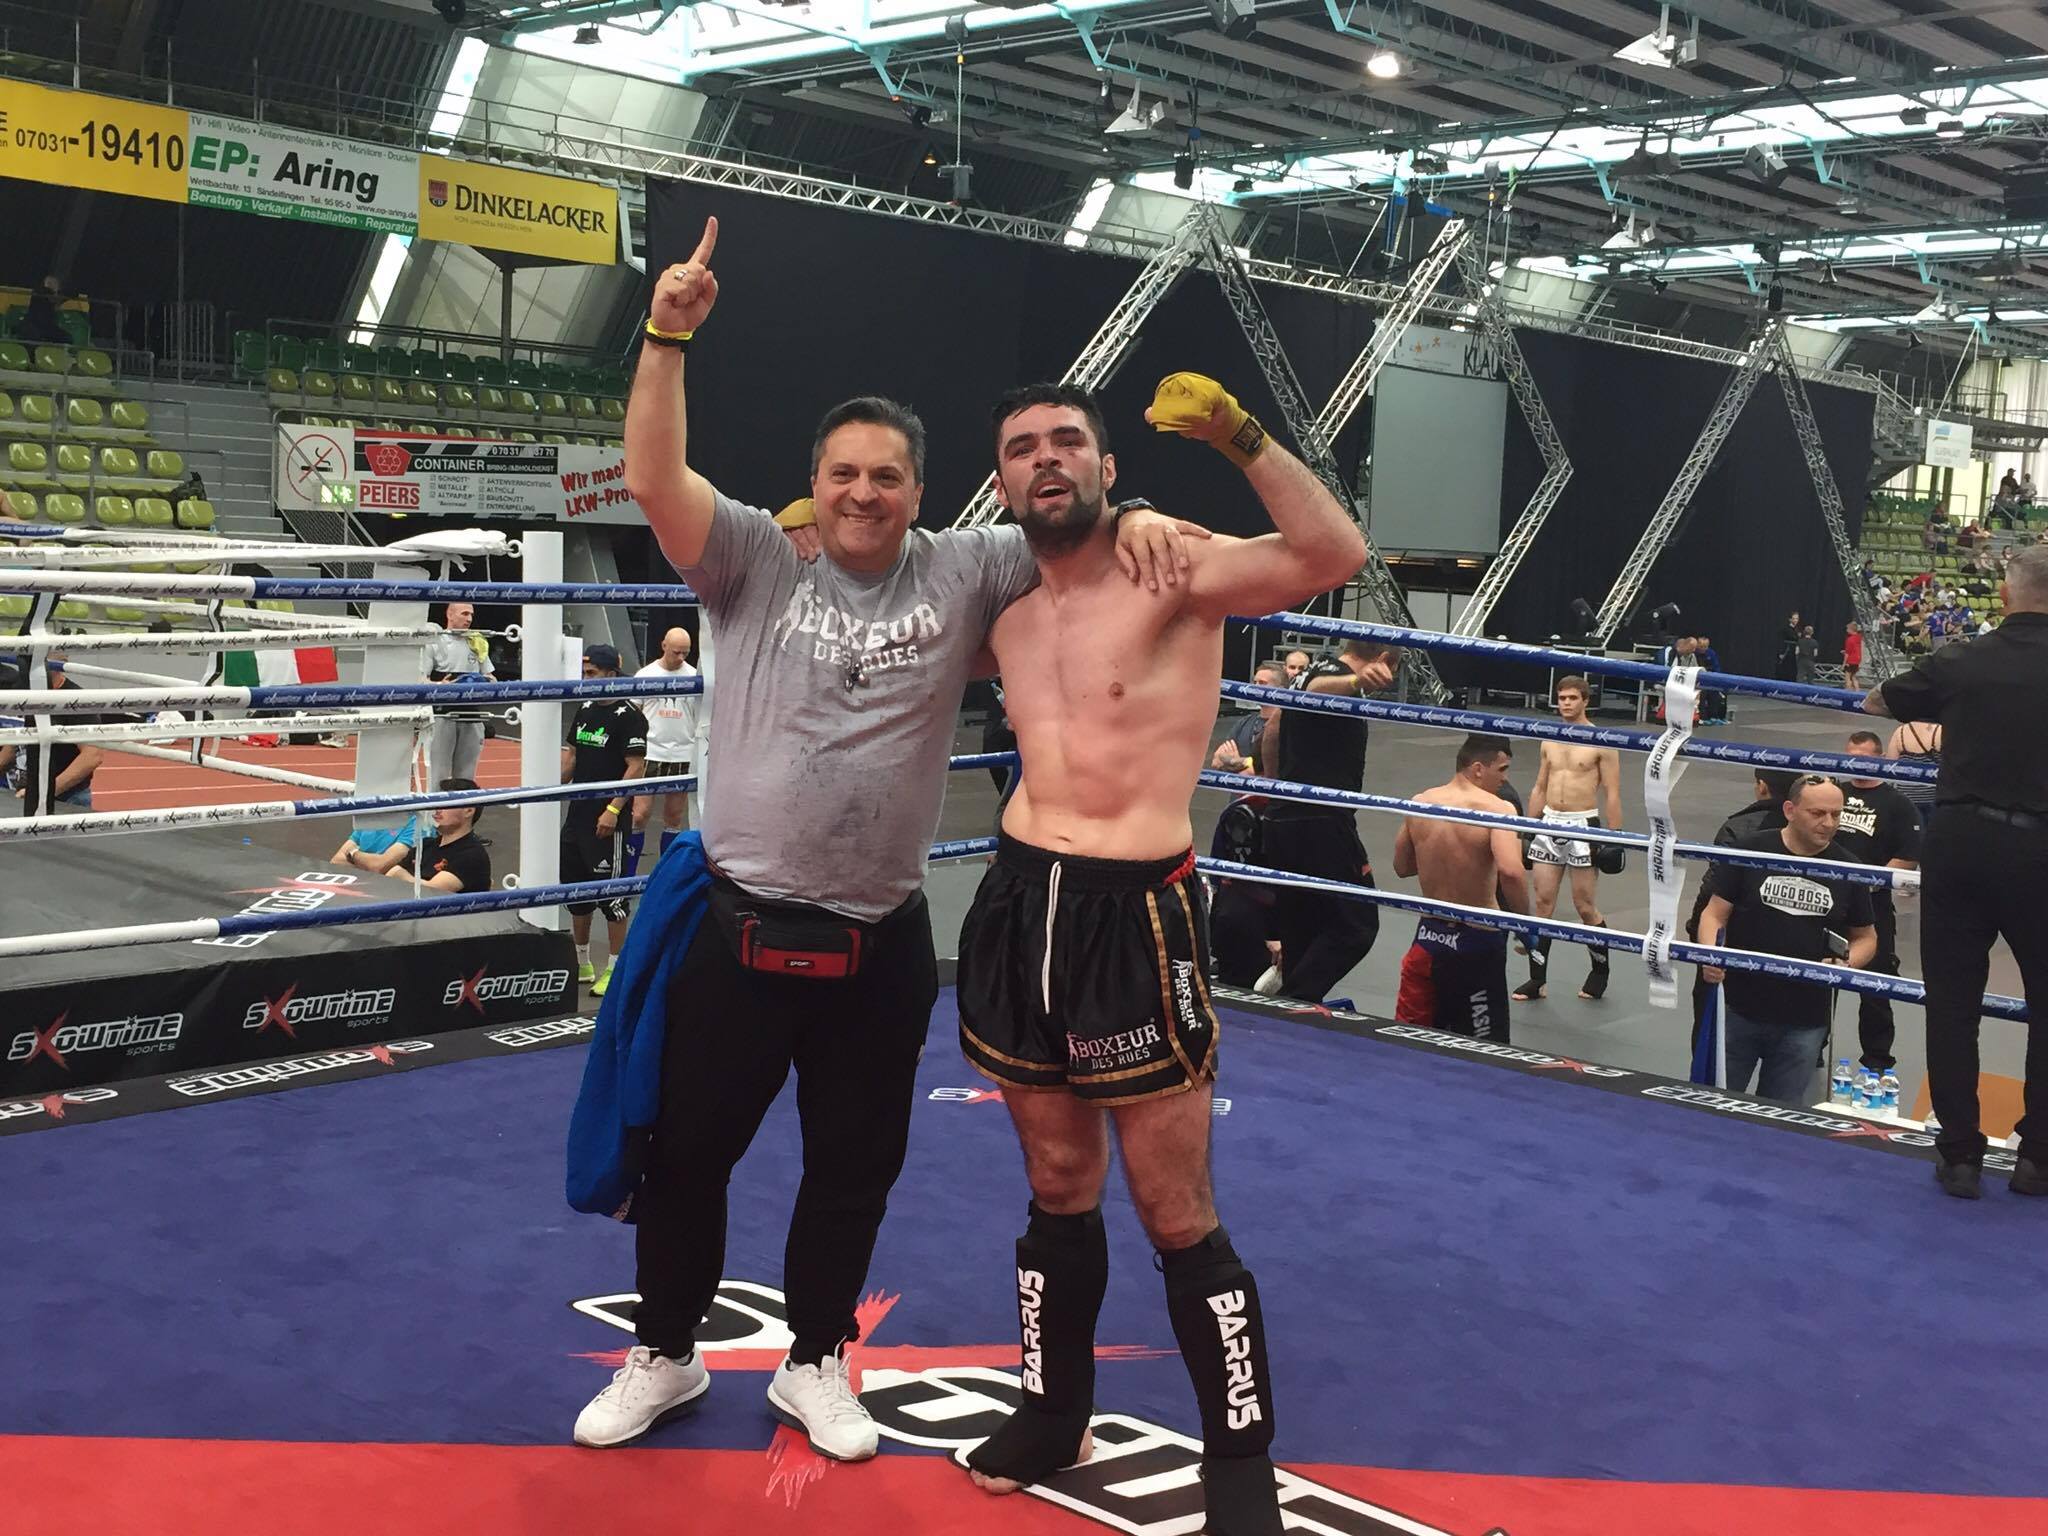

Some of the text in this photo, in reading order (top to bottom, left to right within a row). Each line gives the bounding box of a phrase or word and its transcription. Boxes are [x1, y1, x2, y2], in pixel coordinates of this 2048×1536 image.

[228, 122, 251, 134] Video
[16, 120, 184, 172] 07031-19410
[190, 135, 379, 203] EP: Aring
[256, 186, 305, 202] Sindelfingen
[190, 191, 416, 235] Beratung Verkauf Installation Reparatur
[455, 184, 608, 233] DINKELACKER
[414, 457, 485, 472] CONTAINER
[360, 481, 420, 507] PETERS
[561, 470, 589, 493] Wir
[859, 644, 919, 671] RUES
[1764, 882, 1796, 900] HUGO
[1798, 888, 1830, 907] BOSS
[524, 994, 561, 1006] sports
[1178, 967, 1198, 1032] BOXEUR
[346, 1016, 390, 1029] sports
[125, 1041, 177, 1058] sports
[1077, 1023, 1161, 1060] BOXEUR
[1091, 1046, 1151, 1071] DES RUES
[1017, 1265, 1046, 1396] BARRUS
[1206, 1288, 1264, 1431] BARRUS
